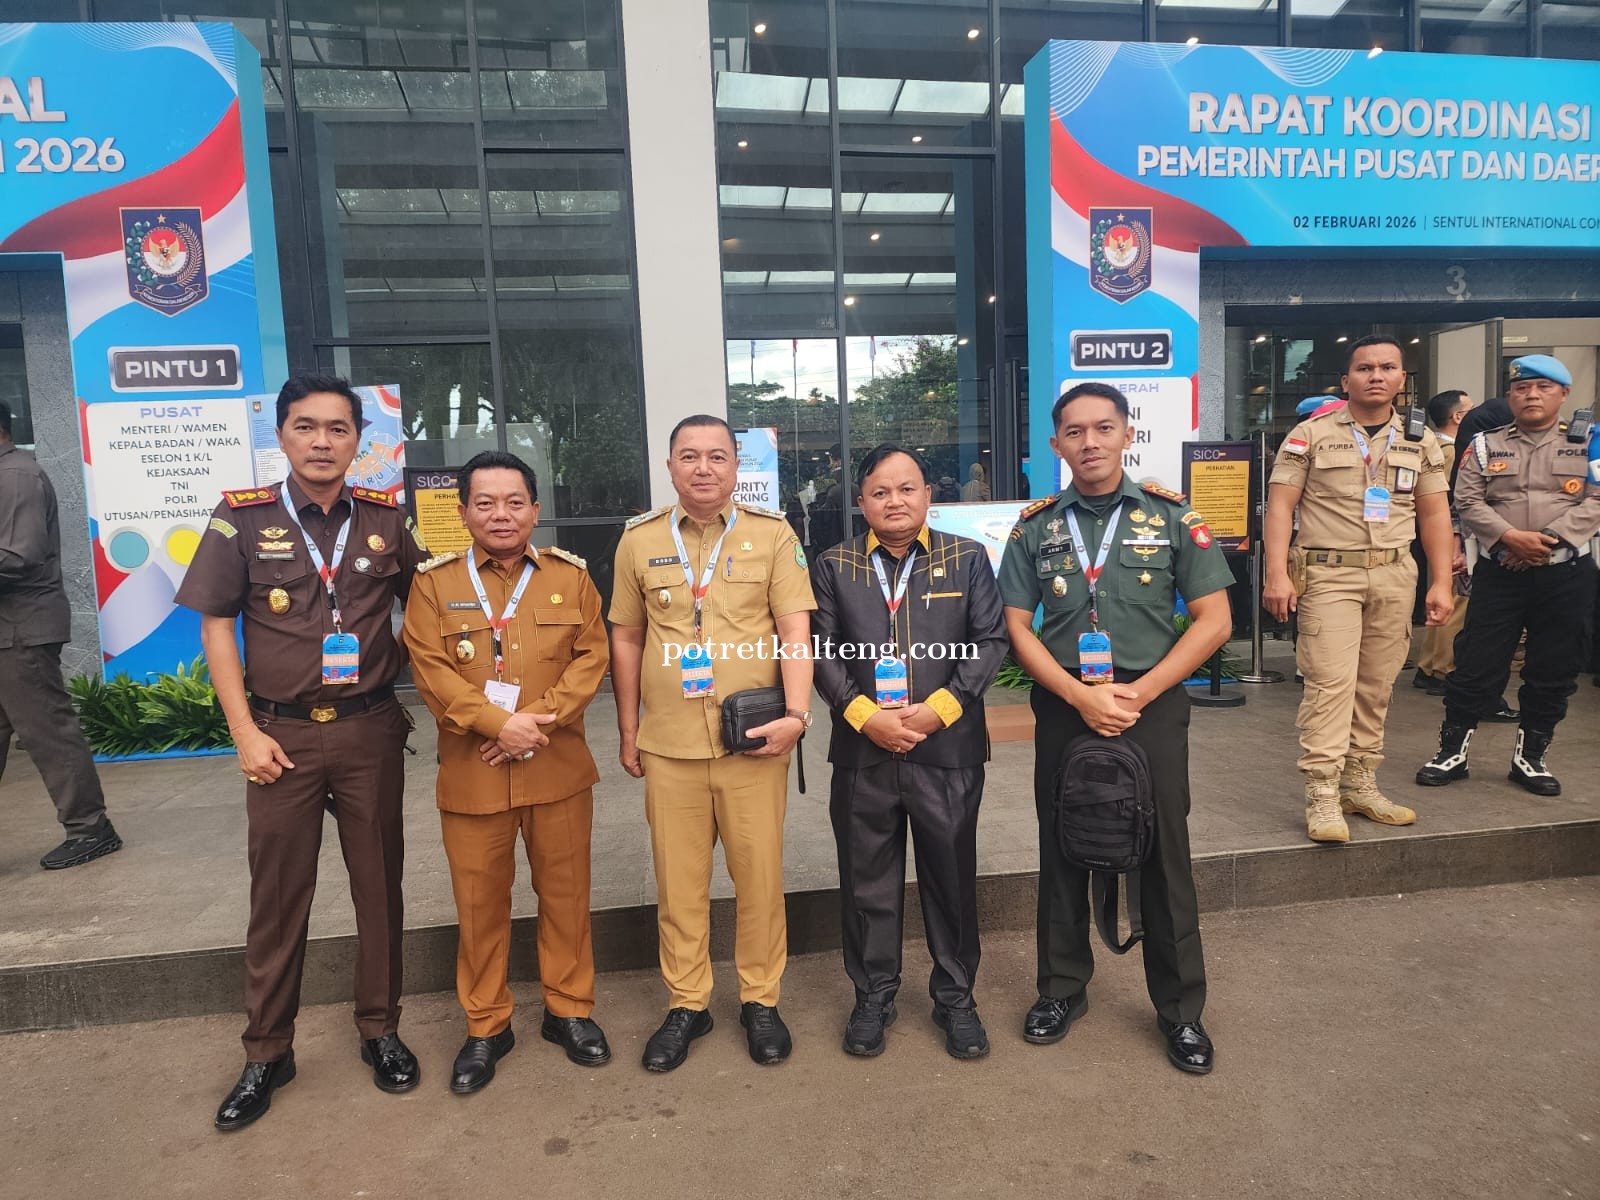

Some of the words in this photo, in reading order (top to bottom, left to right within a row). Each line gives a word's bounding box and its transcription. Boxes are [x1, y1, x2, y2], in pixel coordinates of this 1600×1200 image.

[1189, 92, 1333, 135] RAPAT
[1343, 95, 1591, 142] KOORDINASI
[14, 137, 125, 173] 2026
[1138, 144, 1346, 178] PEMERINTAH
[1354, 148, 1455, 180] PUSAT
[1463, 150, 1526, 180] DAN
[1293, 216, 1309, 228] 02
[1314, 216, 1380, 228] FEBRUARI
[1385, 216, 1416, 228] 2026
[1432, 216, 1479, 228] SENTUL
[1482, 216, 1577, 229] INTERNATIONAL
[1446, 265, 1466, 295] 3
[1081, 342, 1145, 359] PINTU
[1151, 342, 1164, 358] 2
[125, 359, 208, 379] PINTU
[215, 359, 226, 377] 1
[1112, 383, 1159, 393] ERAH
[140, 406, 203, 418] PUSAT
[121, 425, 171, 436] MENTERI
[182, 423, 227, 434] WAMEN
[109, 440, 152, 450] KEPALA
[155, 438, 194, 448] BADAN
[205, 437, 241, 447] WAKA
[1329, 443, 1354, 451] PURBA
[141, 453, 182, 464] ESELON
[185, 453, 190, 462] 1
[194, 453, 212, 462] K/L
[147, 467, 210, 477] KEJAKSAAN
[170, 482, 189, 490] TNI
[165, 495, 198, 504] POLRI
